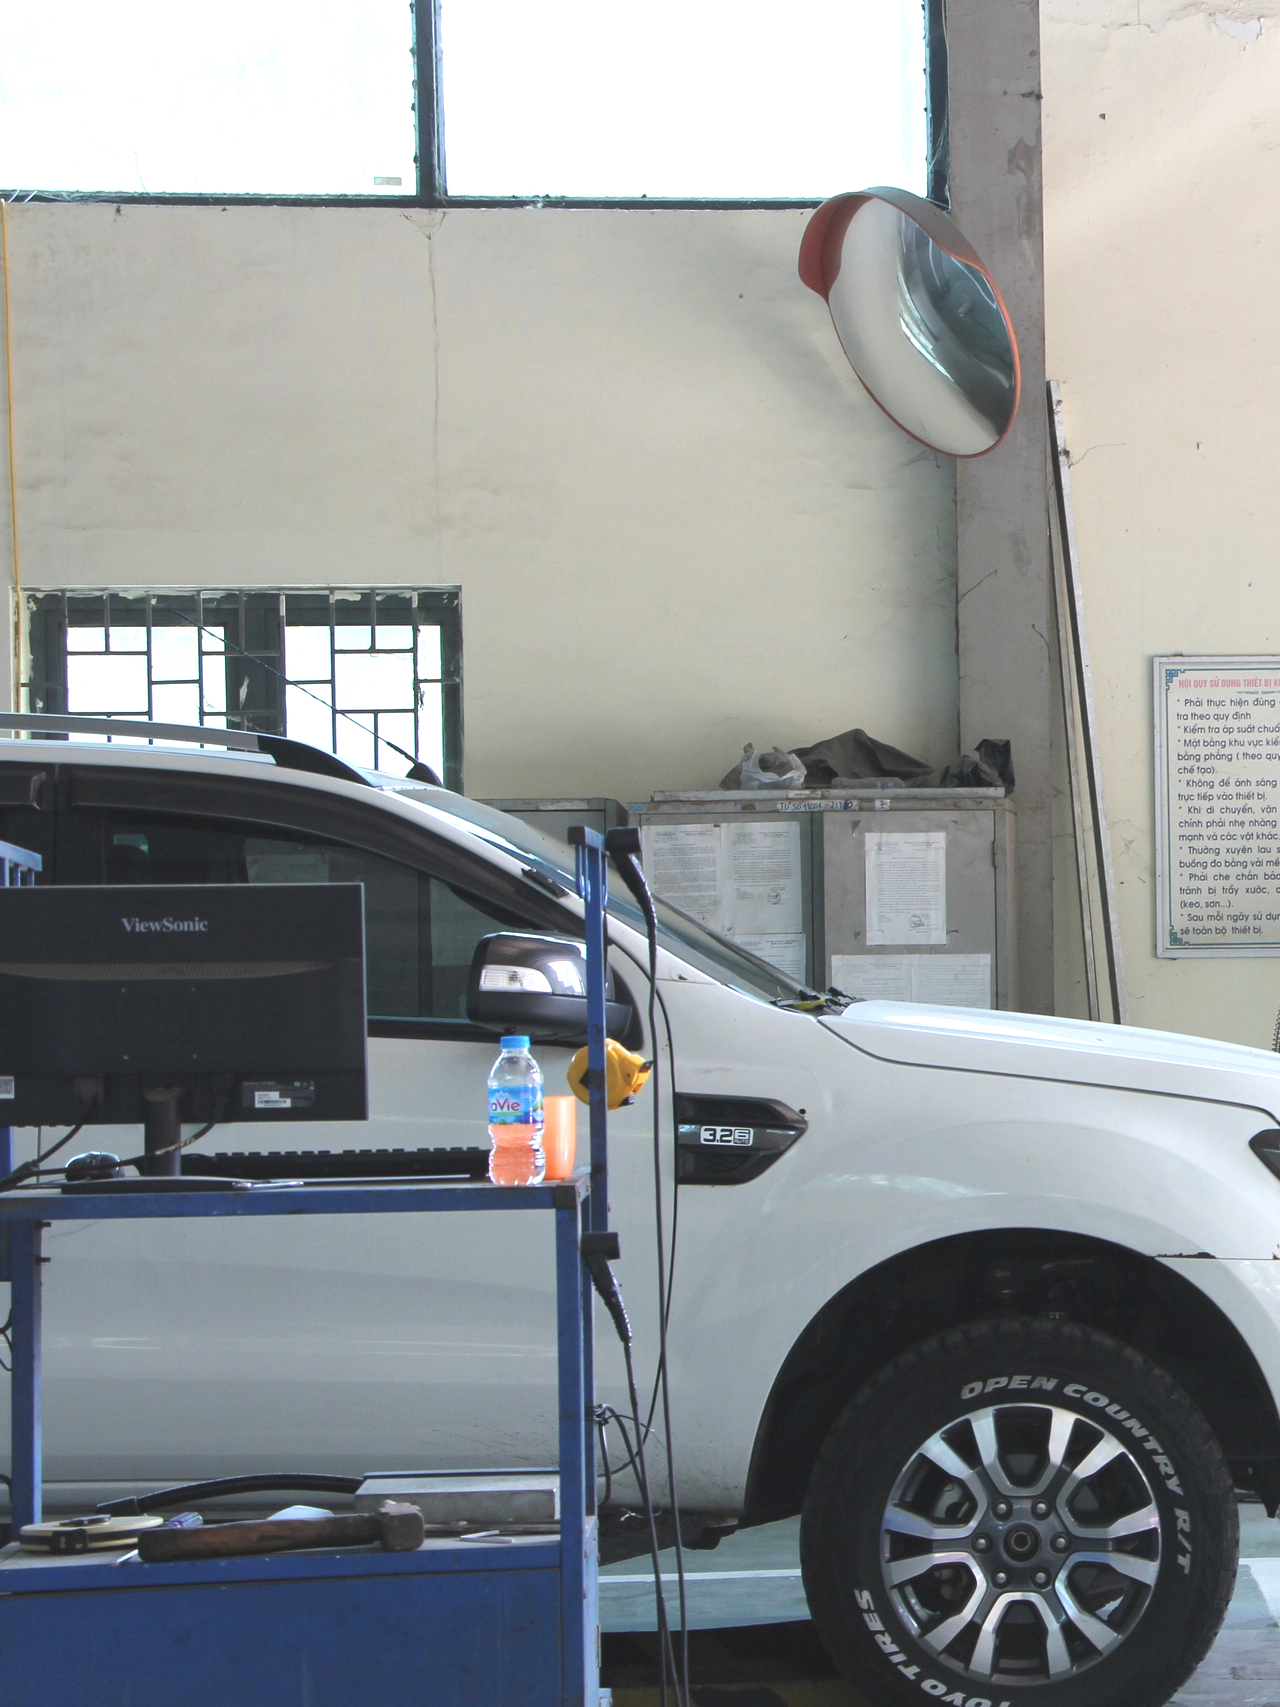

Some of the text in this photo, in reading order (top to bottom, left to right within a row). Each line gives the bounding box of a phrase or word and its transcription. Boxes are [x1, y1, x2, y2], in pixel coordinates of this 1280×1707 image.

[1194, 680, 1207, 688] QUY
[1184, 697, 1203, 707] Phải
[1207, 698, 1226, 709] thực
[1230, 698, 1249, 708] hiện
[1252, 697, 1275, 708] đúng
[1177, 712, 1188, 720] tra
[1191, 712, 1210, 720] theo
[1232, 711, 1251, 722] định
[1183, 723, 1205, 734] Kiểm
[1208, 725, 1220, 734] tra
[1222, 724, 1234, 735] áp
[1237, 724, 1255, 733] suất
[1229, 738, 1245, 747] khu
[1247, 739, 1263, 748] vực
[1242, 752, 1262, 760] theo
[1178, 765, 1195, 774] chế
[1186, 779, 1214, 789] Không
[1219, 777, 1230, 787] để
[1235, 778, 1252, 787] ánh
[1256, 778, 1277, 788] sáng
[1178, 792, 1195, 803] trực
[1197, 791, 1214, 802] tiếp
[1216, 792, 1233, 800] vào
[1236, 791, 1255, 800] thiết
[1188, 806, 1201, 814] Khi
[1260, 805, 1277, 815] vận
[1206, 818, 1226, 829] phải
[1229, 819, 1246, 829] nhẹ
[1249, 818, 1277, 828] nhàng
[1178, 833, 1204, 843] mạnh
[1206, 832, 1217, 840] và
[1220, 832, 1237, 840] các
[1226, 846, 1252, 855] xuyên
[1258, 846, 1271, 854] lau
[1210, 859, 1222, 867] đo
[1189, 872, 1208, 881] Phải
[1180, 886, 1202, 894] tránh
[1208, 886, 1216, 896] bị
[1187, 913, 1204, 921] Sau
[122, 917, 208, 932] ViewSonic
[1192, 926, 1212, 935] toàn
[1215, 926, 1227, 936] bộ
[1232, 925, 1250, 934] thiết
[491, 1098, 520, 1111] aVie
[703, 1128, 733, 1144] 3.2
[960, 1375, 1192, 1575] OPEN COUNTRY R/T
[854, 1589, 1010, 1707] OYO TIRES
